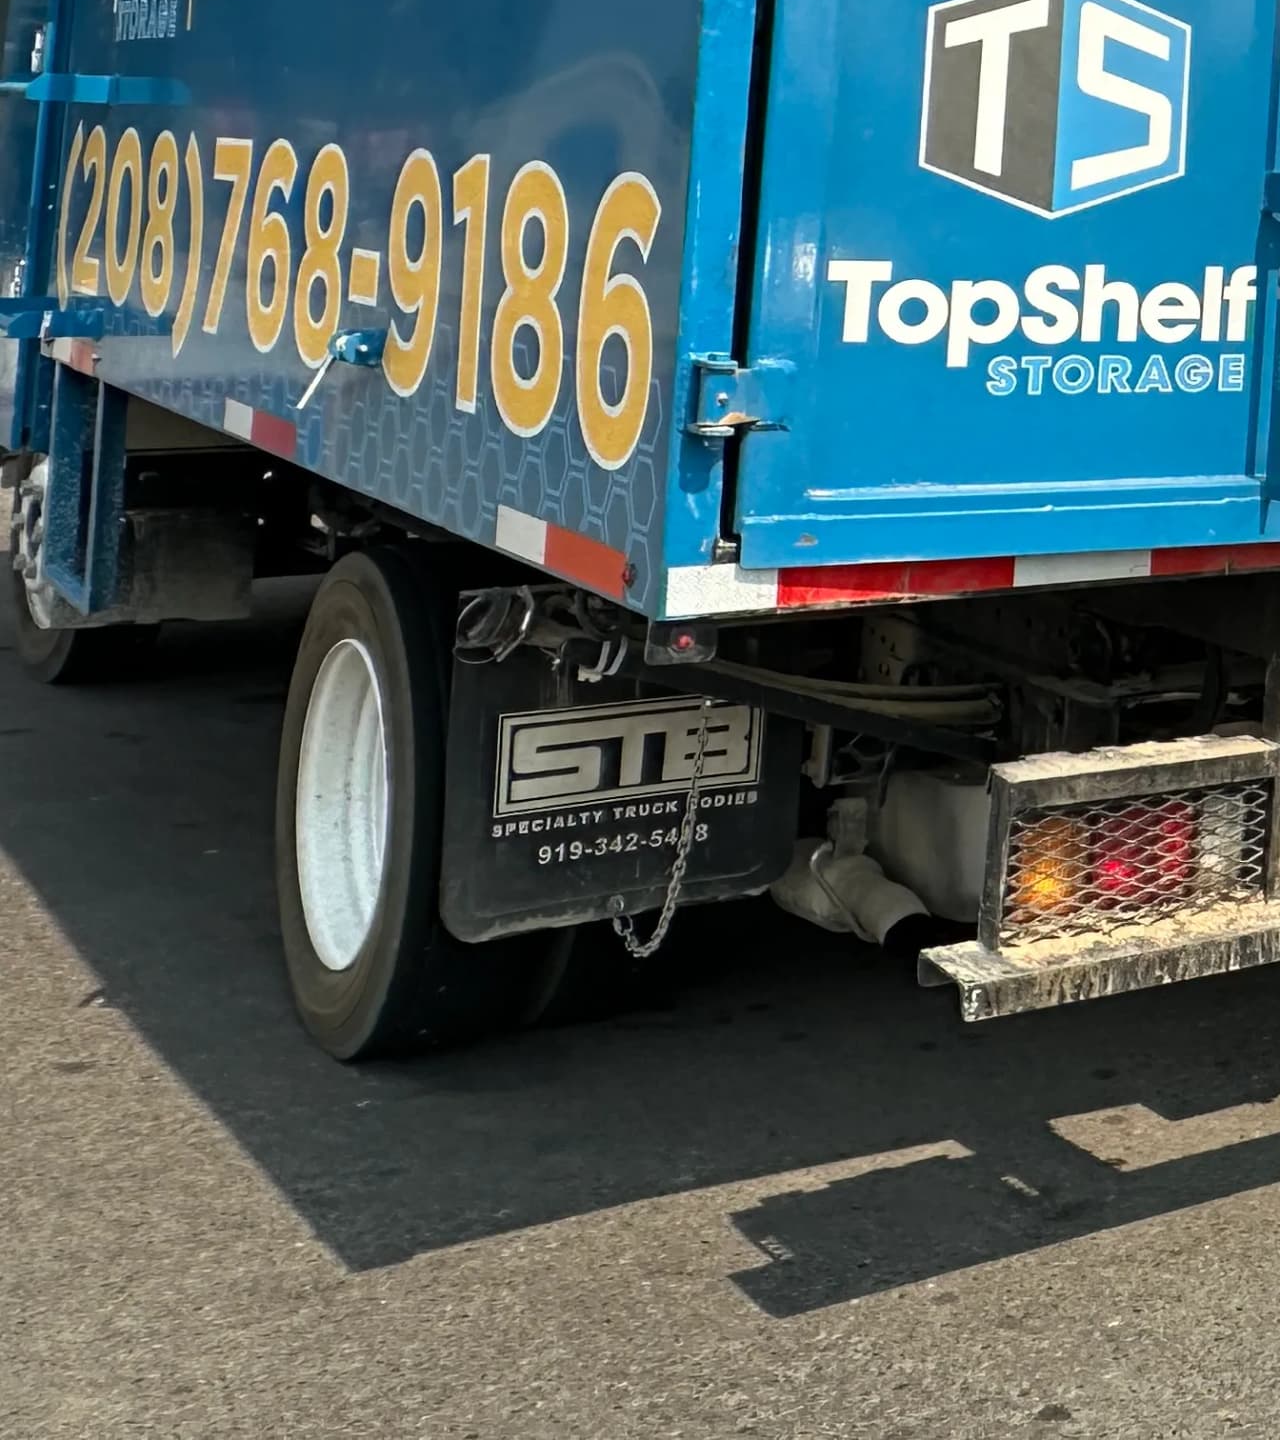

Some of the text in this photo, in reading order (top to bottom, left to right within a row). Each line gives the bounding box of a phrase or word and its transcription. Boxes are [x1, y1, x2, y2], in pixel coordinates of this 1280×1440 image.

[56, 120, 662, 471] (208)768-9186
[827, 260, 1257, 368] TopShelf
[985, 353, 1245, 396] STORAGE
[509, 704, 752, 802] STB
[491, 810, 603, 838] SPECIALTY
[612, 799, 679, 821] TRUCK
[537, 822, 709, 865] 919-342-548
